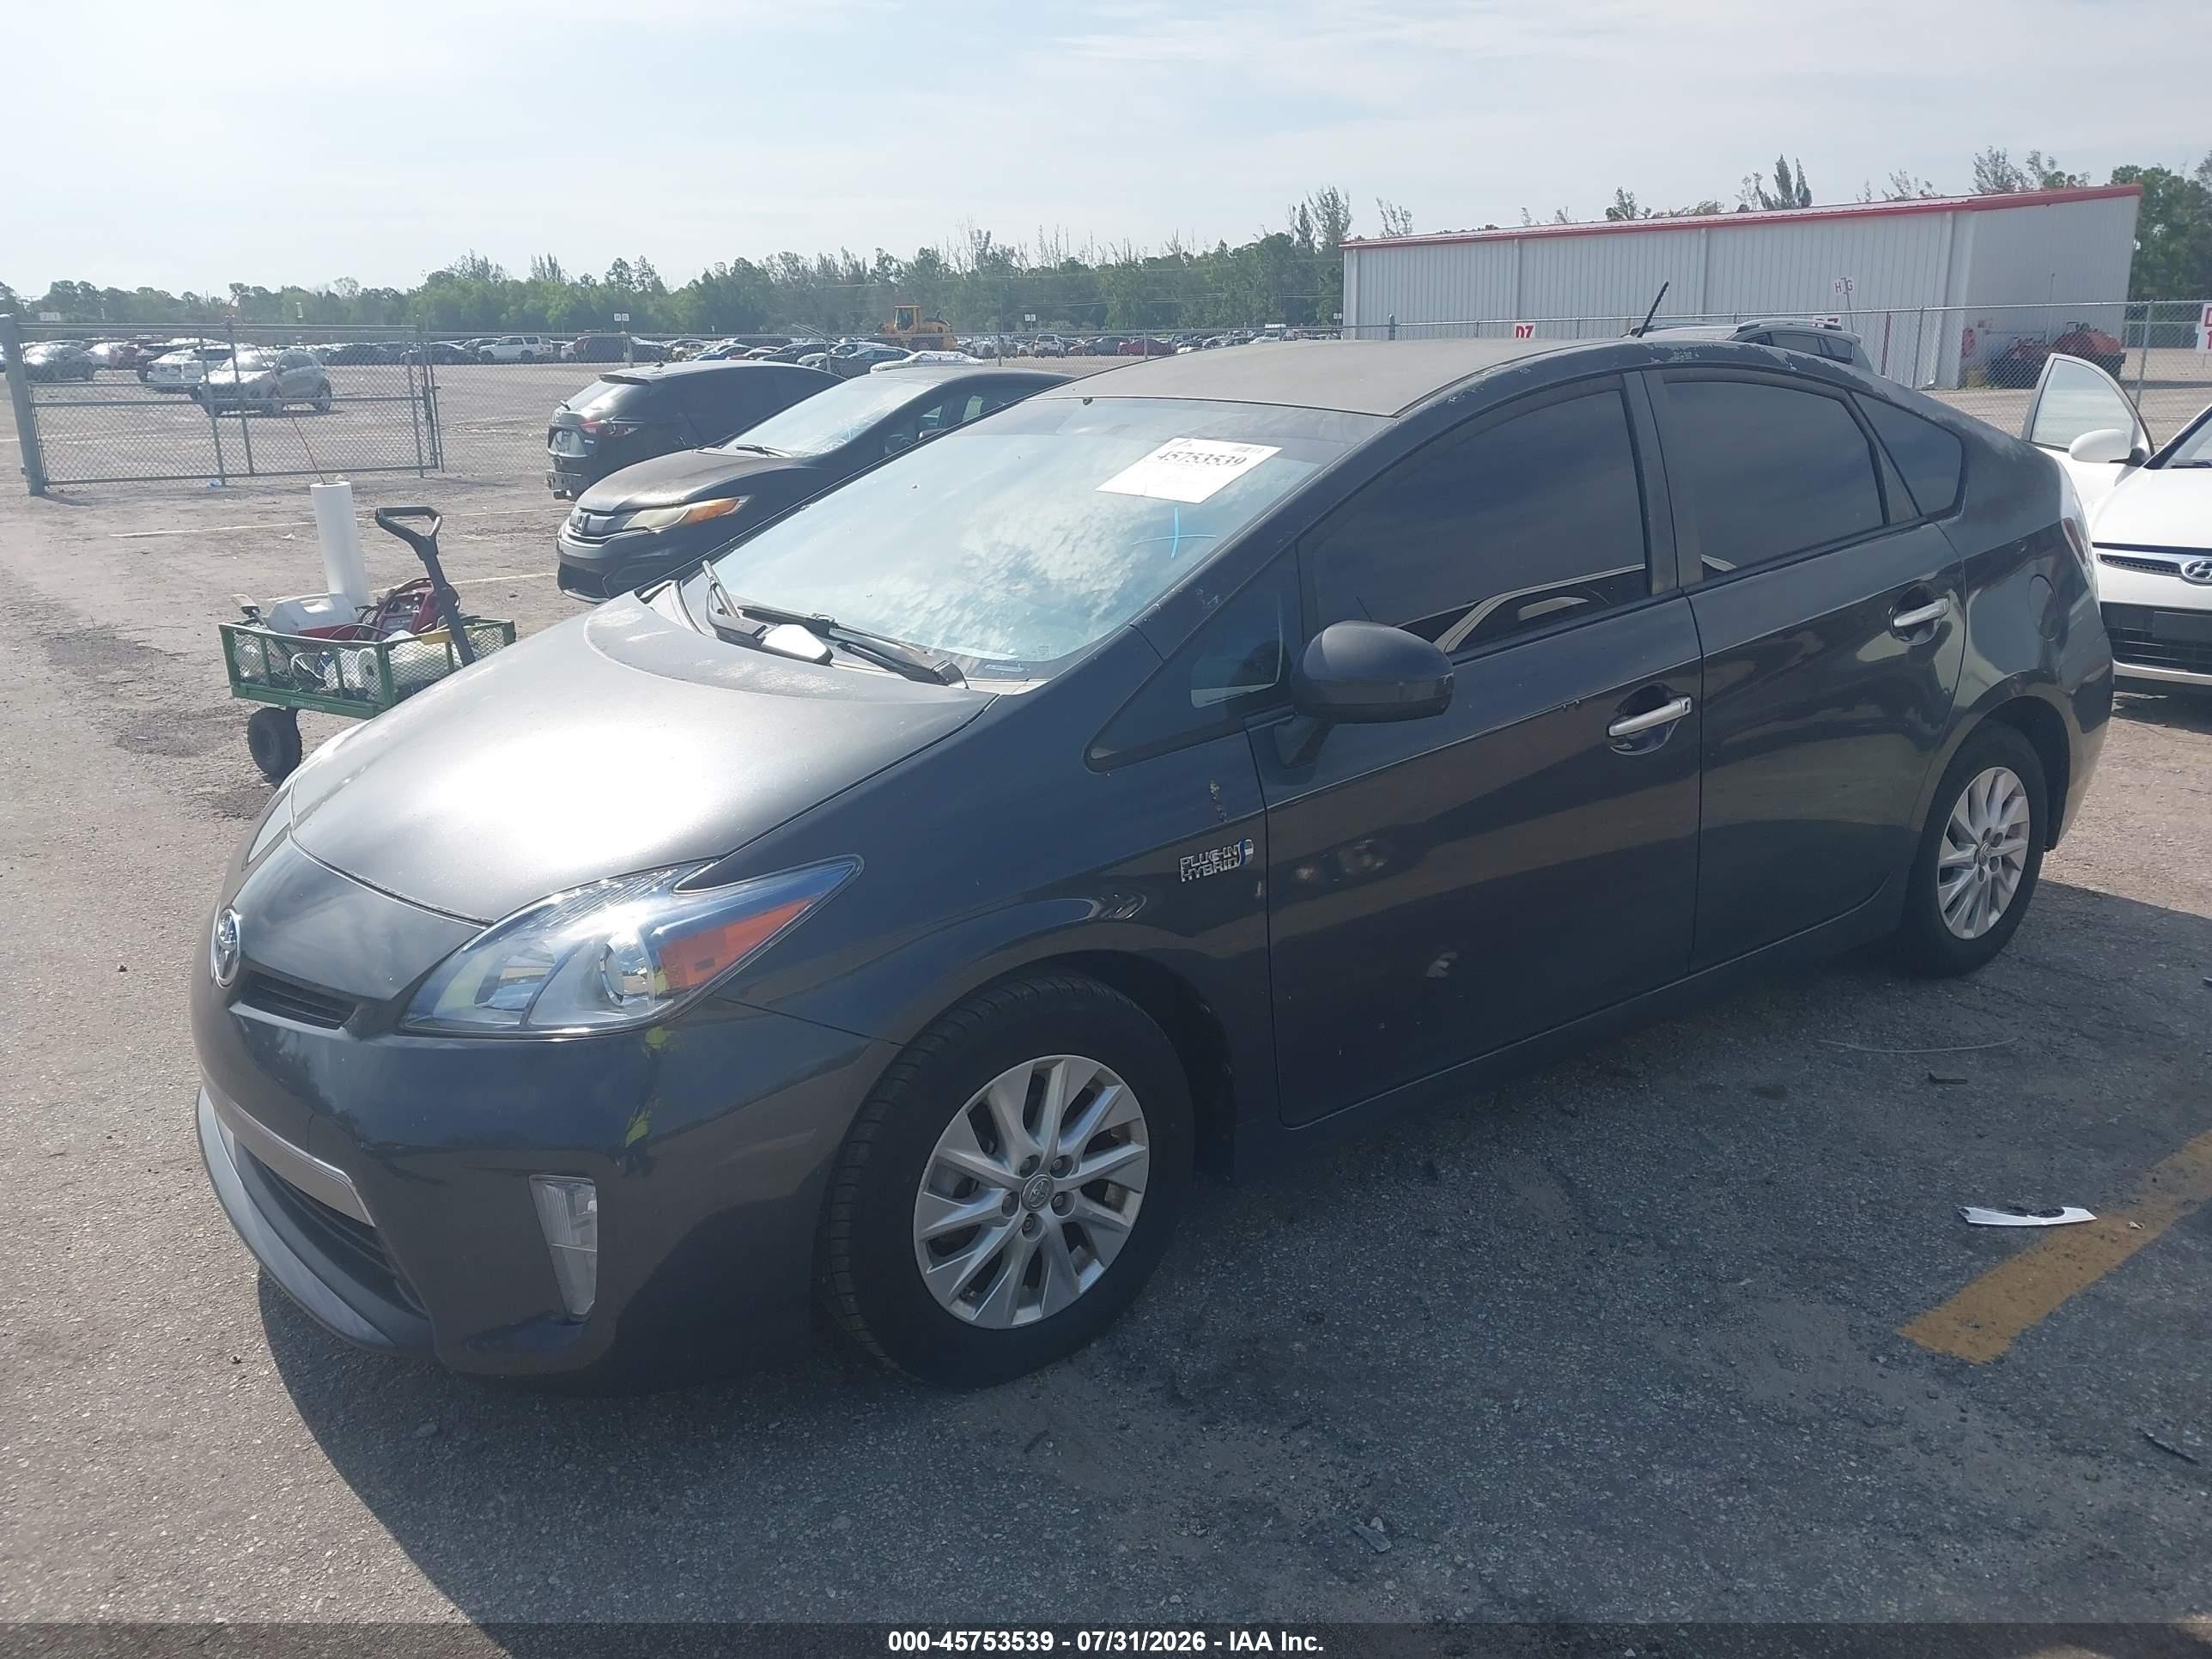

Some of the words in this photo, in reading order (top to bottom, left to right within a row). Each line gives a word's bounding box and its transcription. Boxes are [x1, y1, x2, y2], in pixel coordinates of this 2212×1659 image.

[1157, 450, 1248, 466] 45753539
[1180, 844, 1240, 869] PLUG-IN
[1181, 857, 1242, 883] HYBRID
